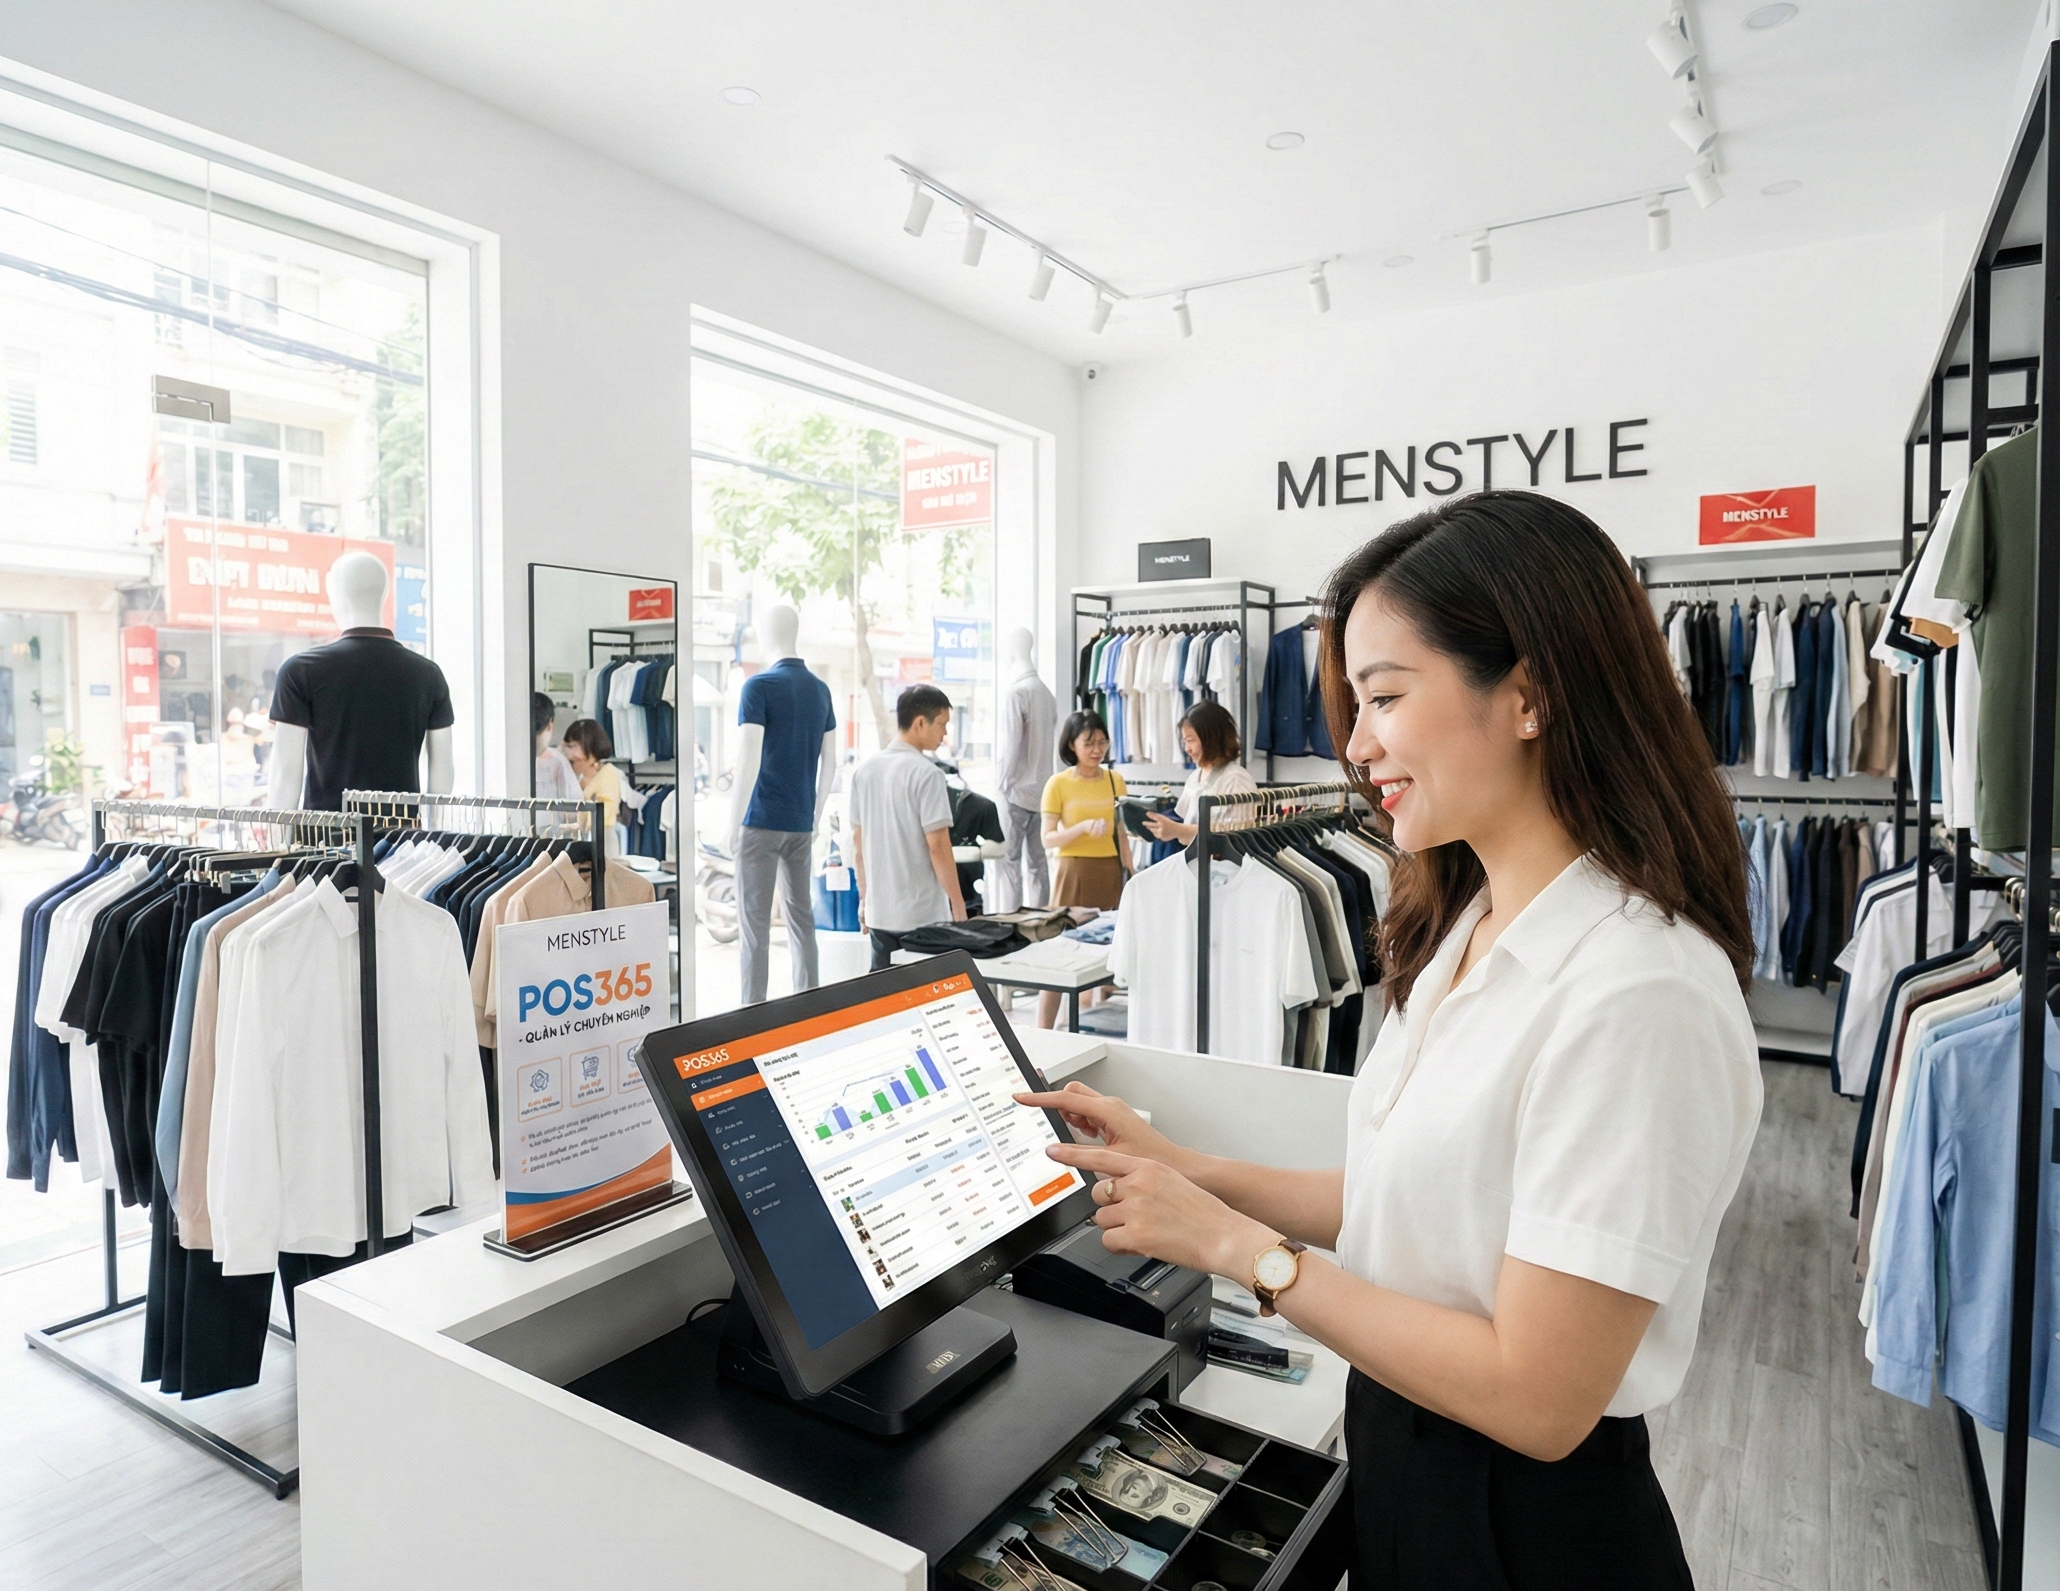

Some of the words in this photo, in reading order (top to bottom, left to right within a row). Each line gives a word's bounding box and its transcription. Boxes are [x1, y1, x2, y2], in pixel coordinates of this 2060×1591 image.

[907, 460, 990, 491] MENSTYLE
[1277, 418, 1648, 510] MENSTYLE
[547, 924, 626, 951] MENSTYLE
[519, 962, 653, 1023] POS365
[560, 1021, 571, 1036] LÝ
